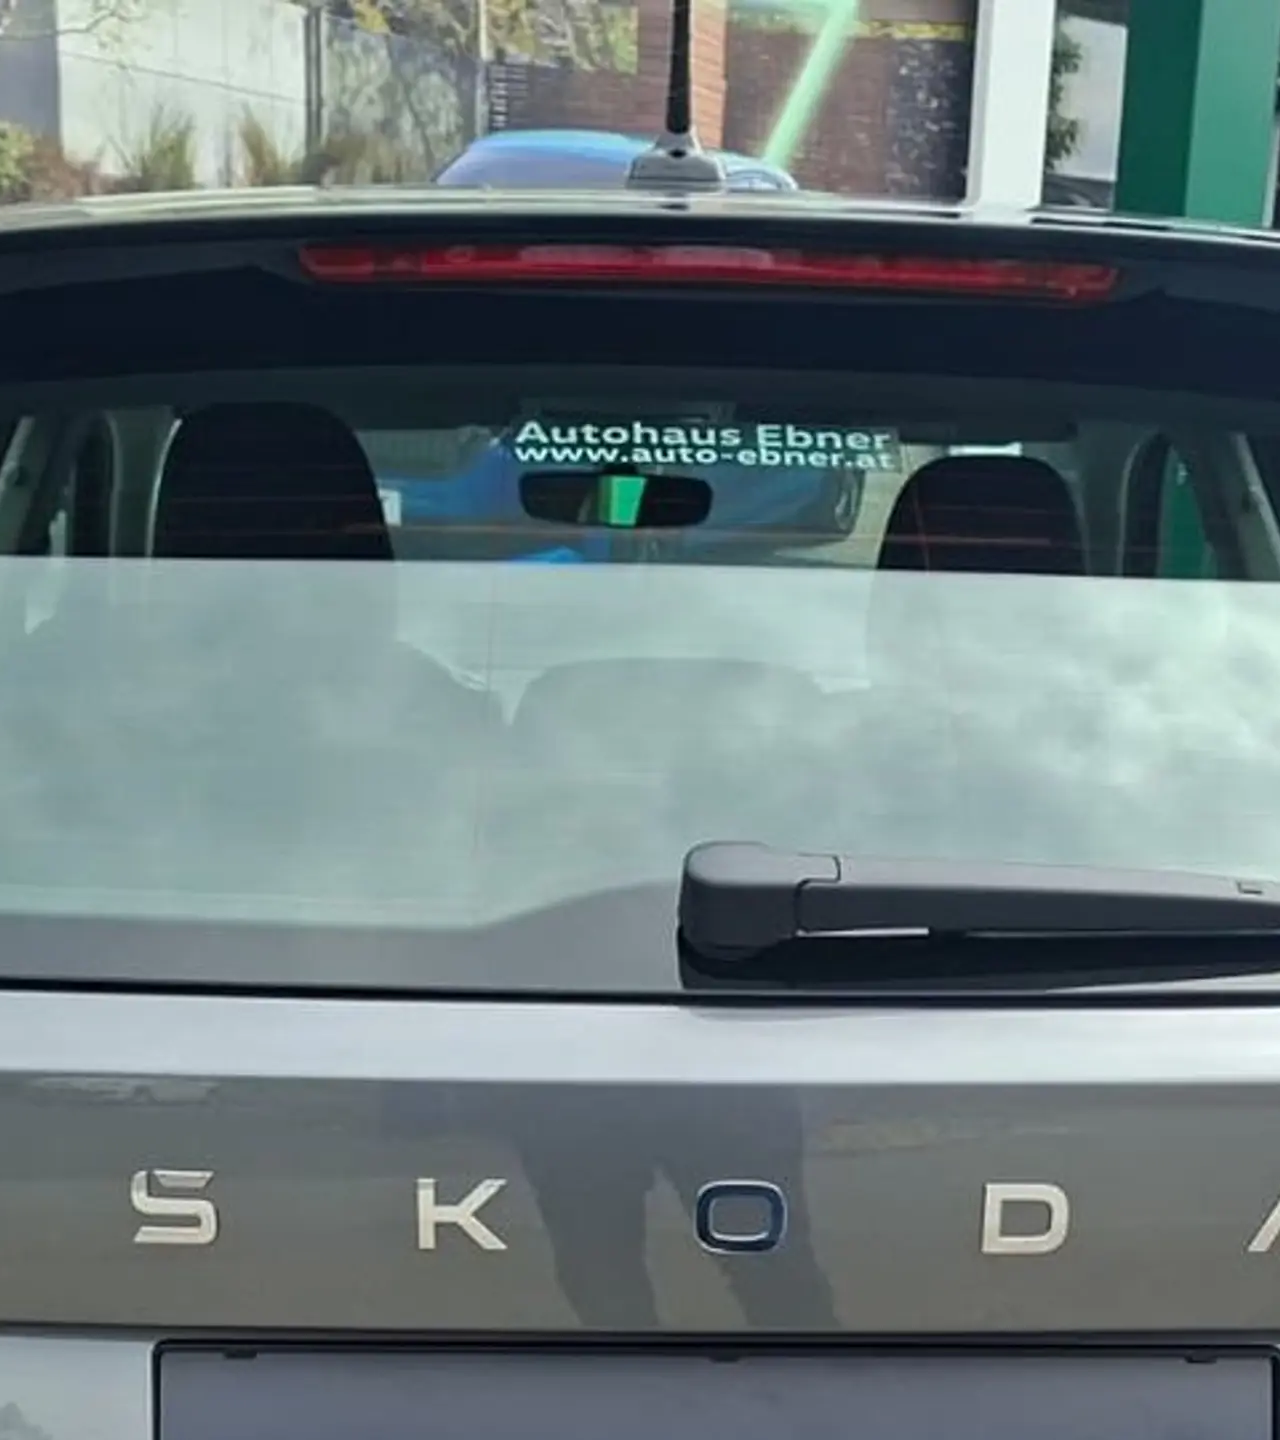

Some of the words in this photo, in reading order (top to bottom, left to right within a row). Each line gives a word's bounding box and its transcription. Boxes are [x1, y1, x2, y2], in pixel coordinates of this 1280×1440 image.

[516, 420, 741, 447] Autohaus
[756, 424, 892, 449] Ebner
[515, 446, 894, 470] www.auto-ebner.at
